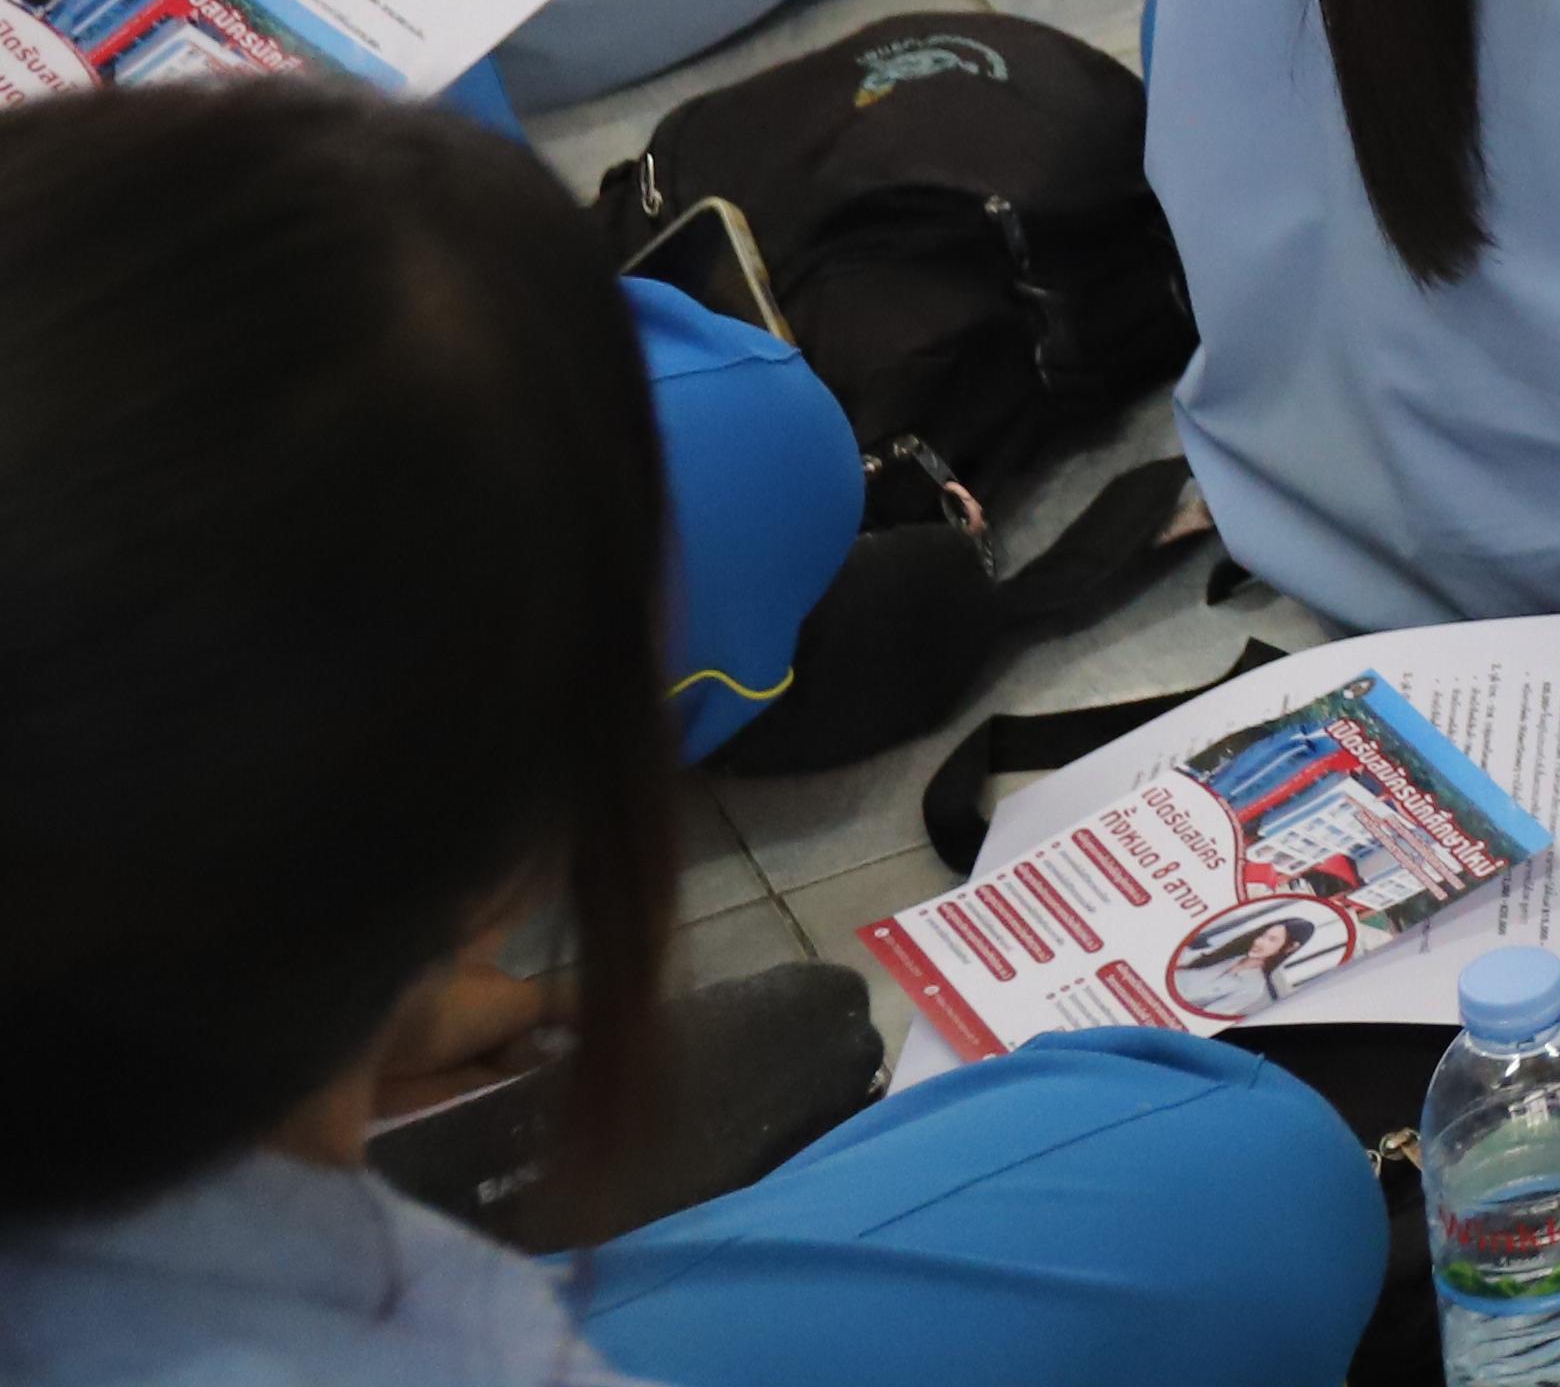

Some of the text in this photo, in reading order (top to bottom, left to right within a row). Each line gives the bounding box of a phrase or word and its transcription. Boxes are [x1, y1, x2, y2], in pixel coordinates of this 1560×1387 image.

[1141, 787, 1227, 870] เปิดรับสมัคร
[1326, 718, 1505, 878] เปิดรับสมัครนักศึกษาใหม่
[1099, 806, 1161, 868] ทั้งหมด
[1151, 861, 1181, 880] 8
[1163, 878, 1209, 919] สาขา
